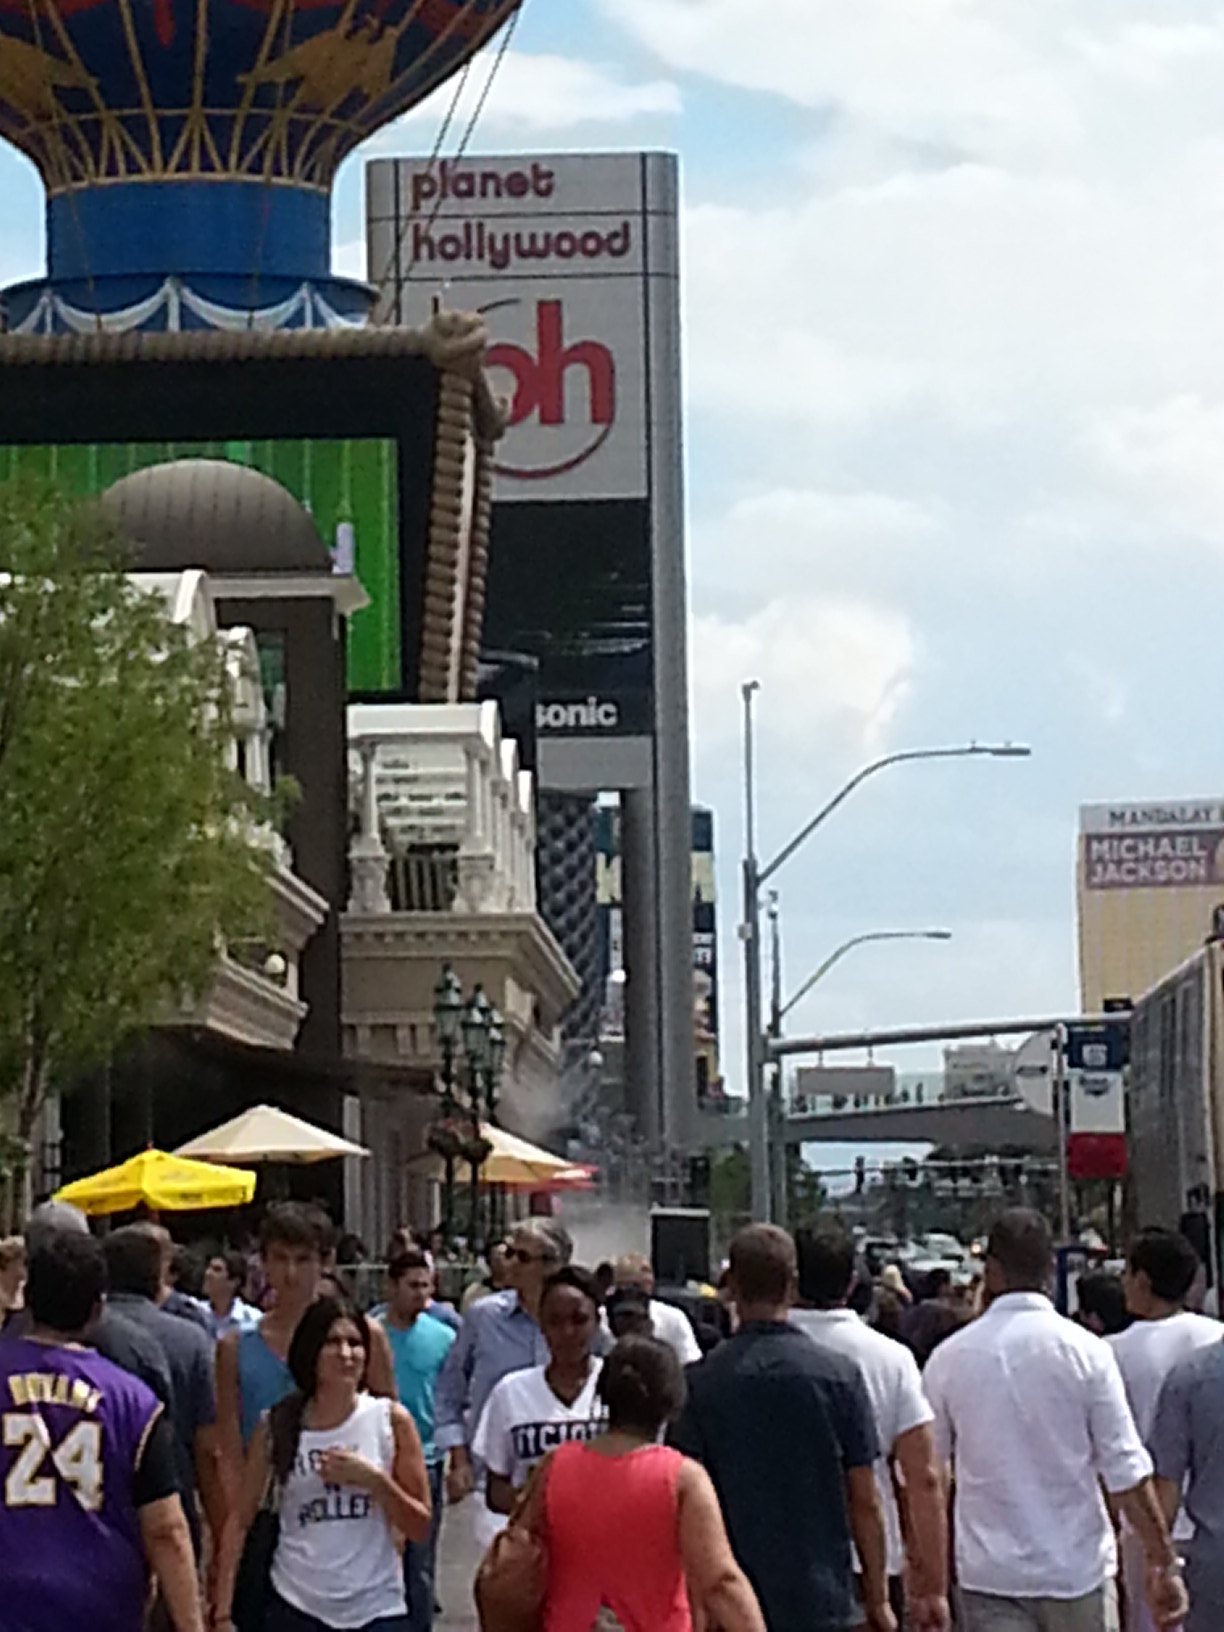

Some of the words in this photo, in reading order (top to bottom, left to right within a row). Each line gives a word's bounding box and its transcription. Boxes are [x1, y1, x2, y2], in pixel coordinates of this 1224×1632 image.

[411, 159, 555, 212] planet
[412, 220, 631, 270] hollywood
[1090, 835, 1208, 862] MICHAEL
[1090, 858, 1207, 883] JACKSON
[1, 1412, 104, 1513] 24
